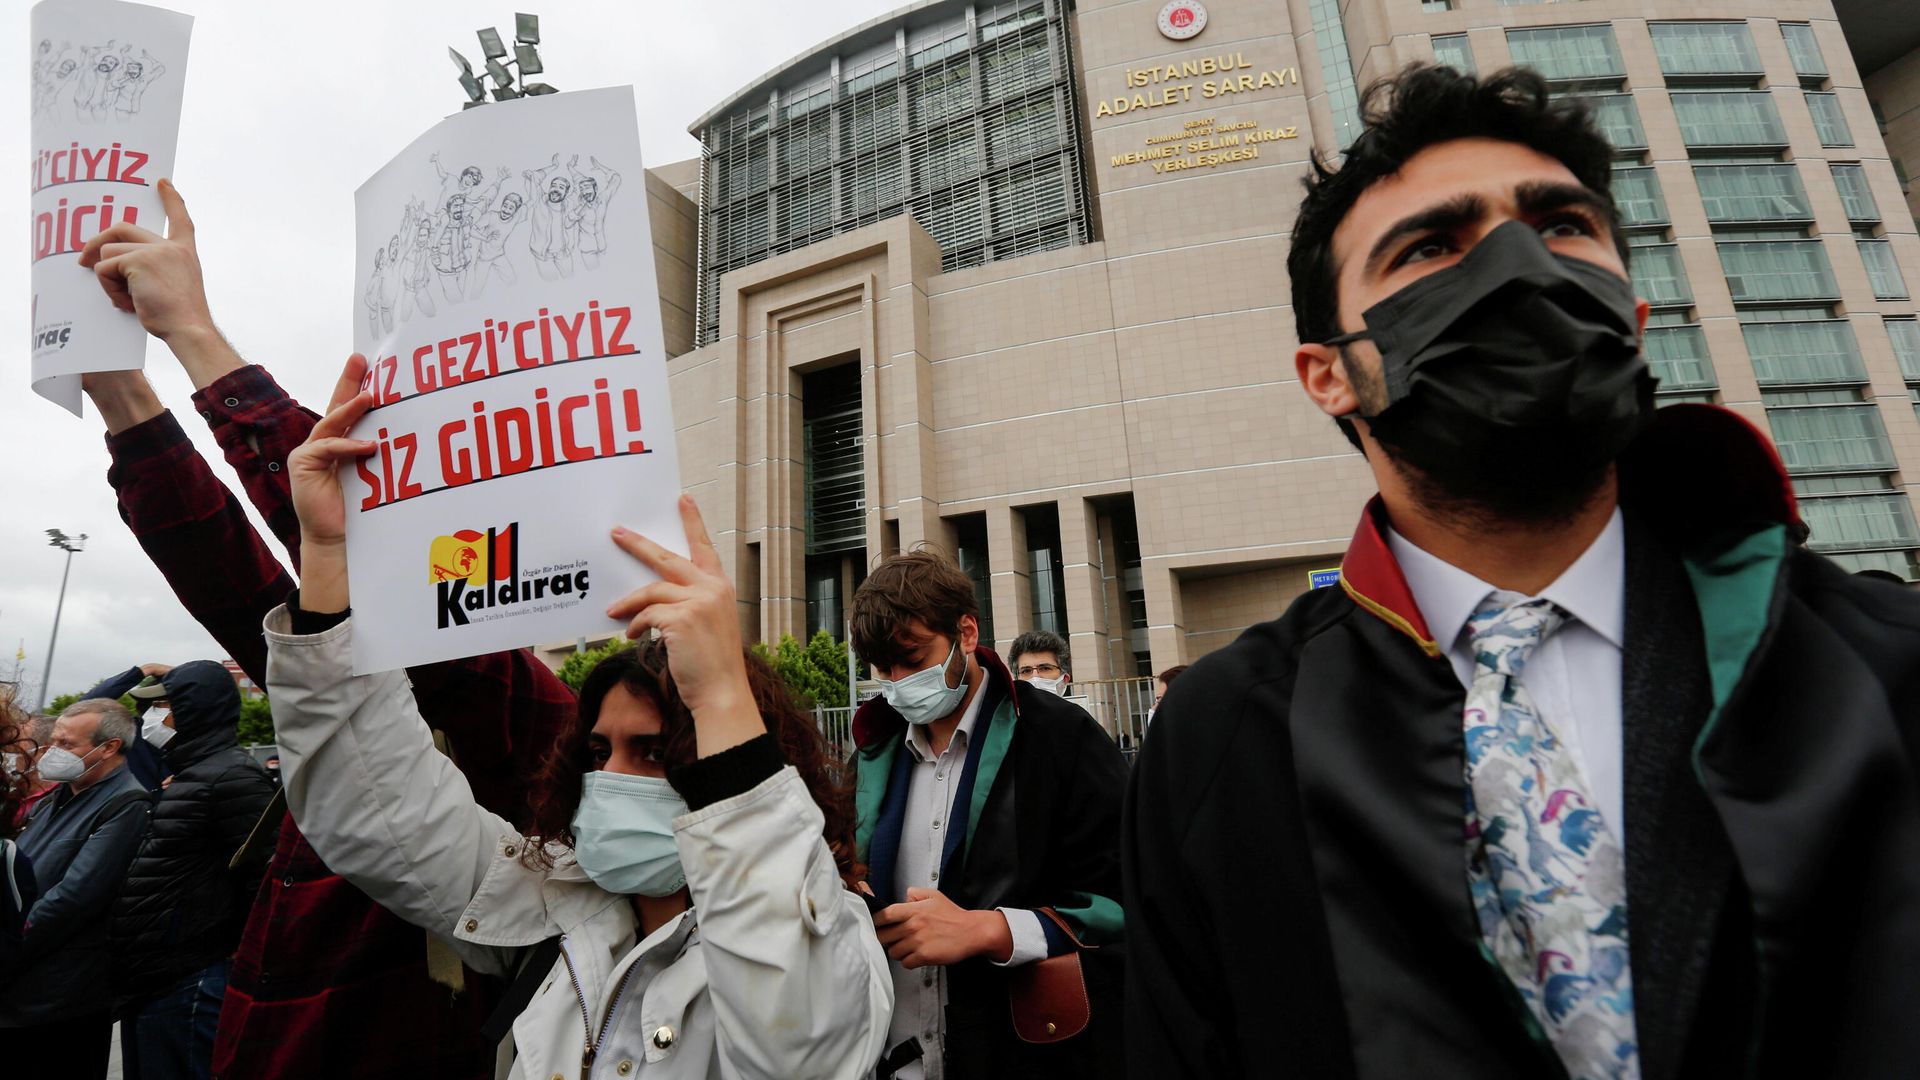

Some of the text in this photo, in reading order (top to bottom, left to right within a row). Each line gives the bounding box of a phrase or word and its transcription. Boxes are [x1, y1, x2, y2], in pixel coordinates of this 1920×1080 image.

[1126, 52, 1253, 88] İSTANBUL
[1096, 67, 1297, 118] ADALET SARAYI
[1111, 126, 1298, 168] MEHMET SELİM KİRAZ
[1216, 120, 1257, 134] SAVCISI
[1152, 145, 1259, 174] YERLEŞKESİ
[357, 378, 645, 511] SİZ GİDİCİ!
[437, 522, 590, 629] Kaldıraç
